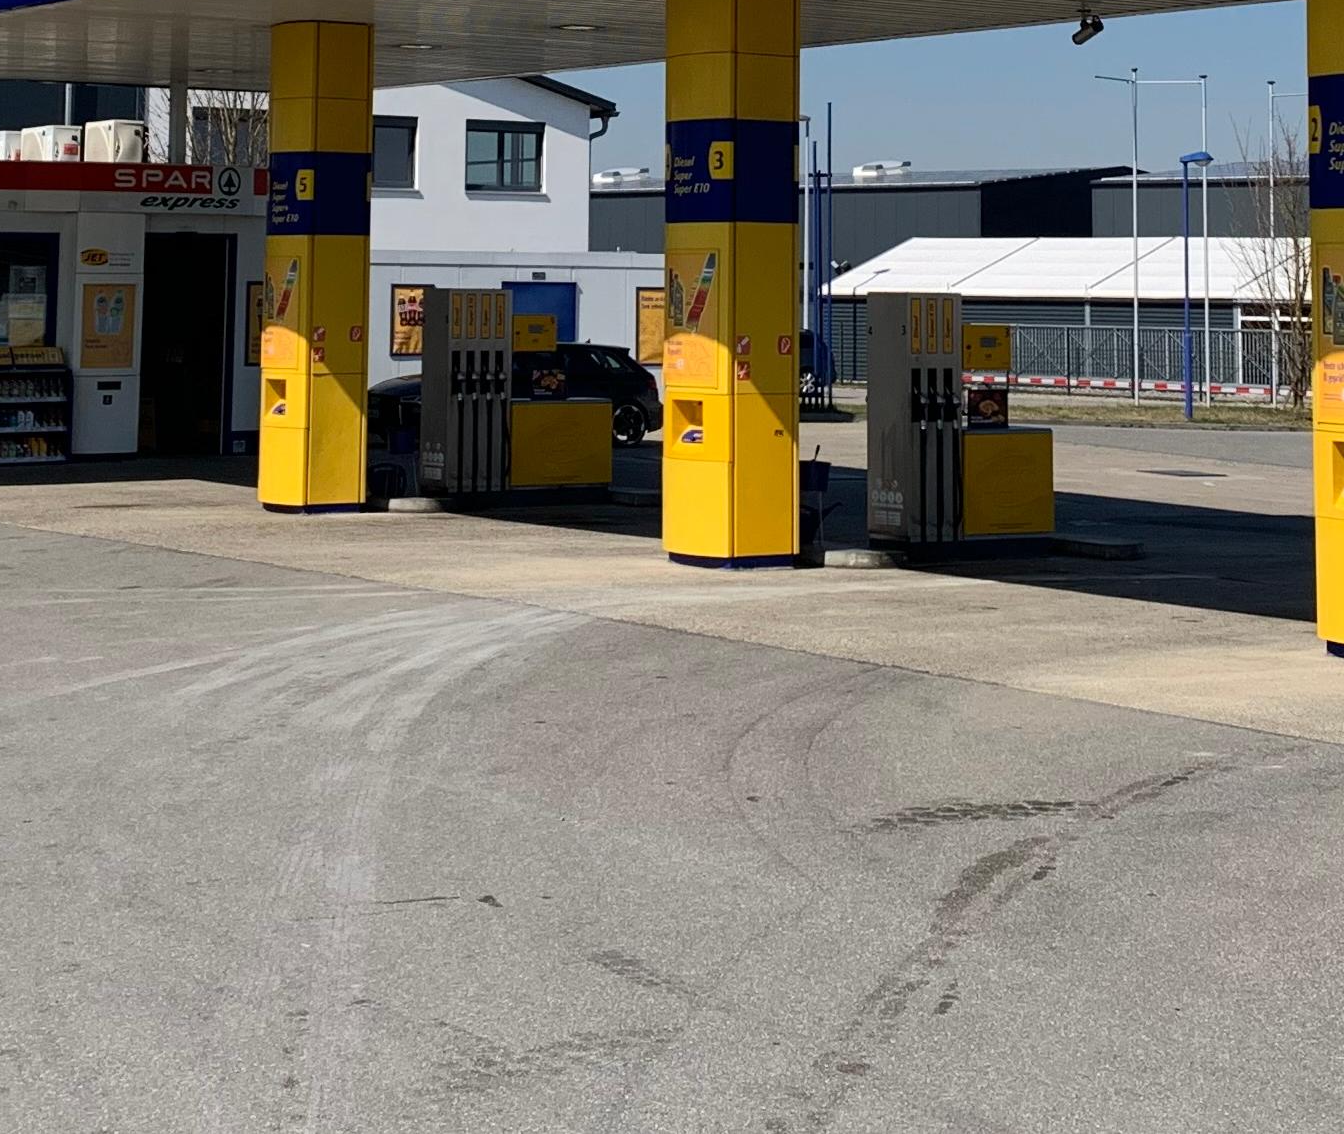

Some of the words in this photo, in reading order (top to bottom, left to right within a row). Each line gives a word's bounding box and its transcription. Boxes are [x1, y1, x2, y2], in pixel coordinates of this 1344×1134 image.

[673, 155, 696, 167] Diesel
[713, 150, 724, 170] 3
[114, 168, 212, 190] SPAR
[299, 176, 307, 193] 5
[673, 170, 693, 184] Super
[673, 183, 693, 197] Super
[693, 182, 711, 193] E10
[140, 195, 241, 211] express
[84, 252, 104, 262] JET
[901, 324, 907, 336] 3
